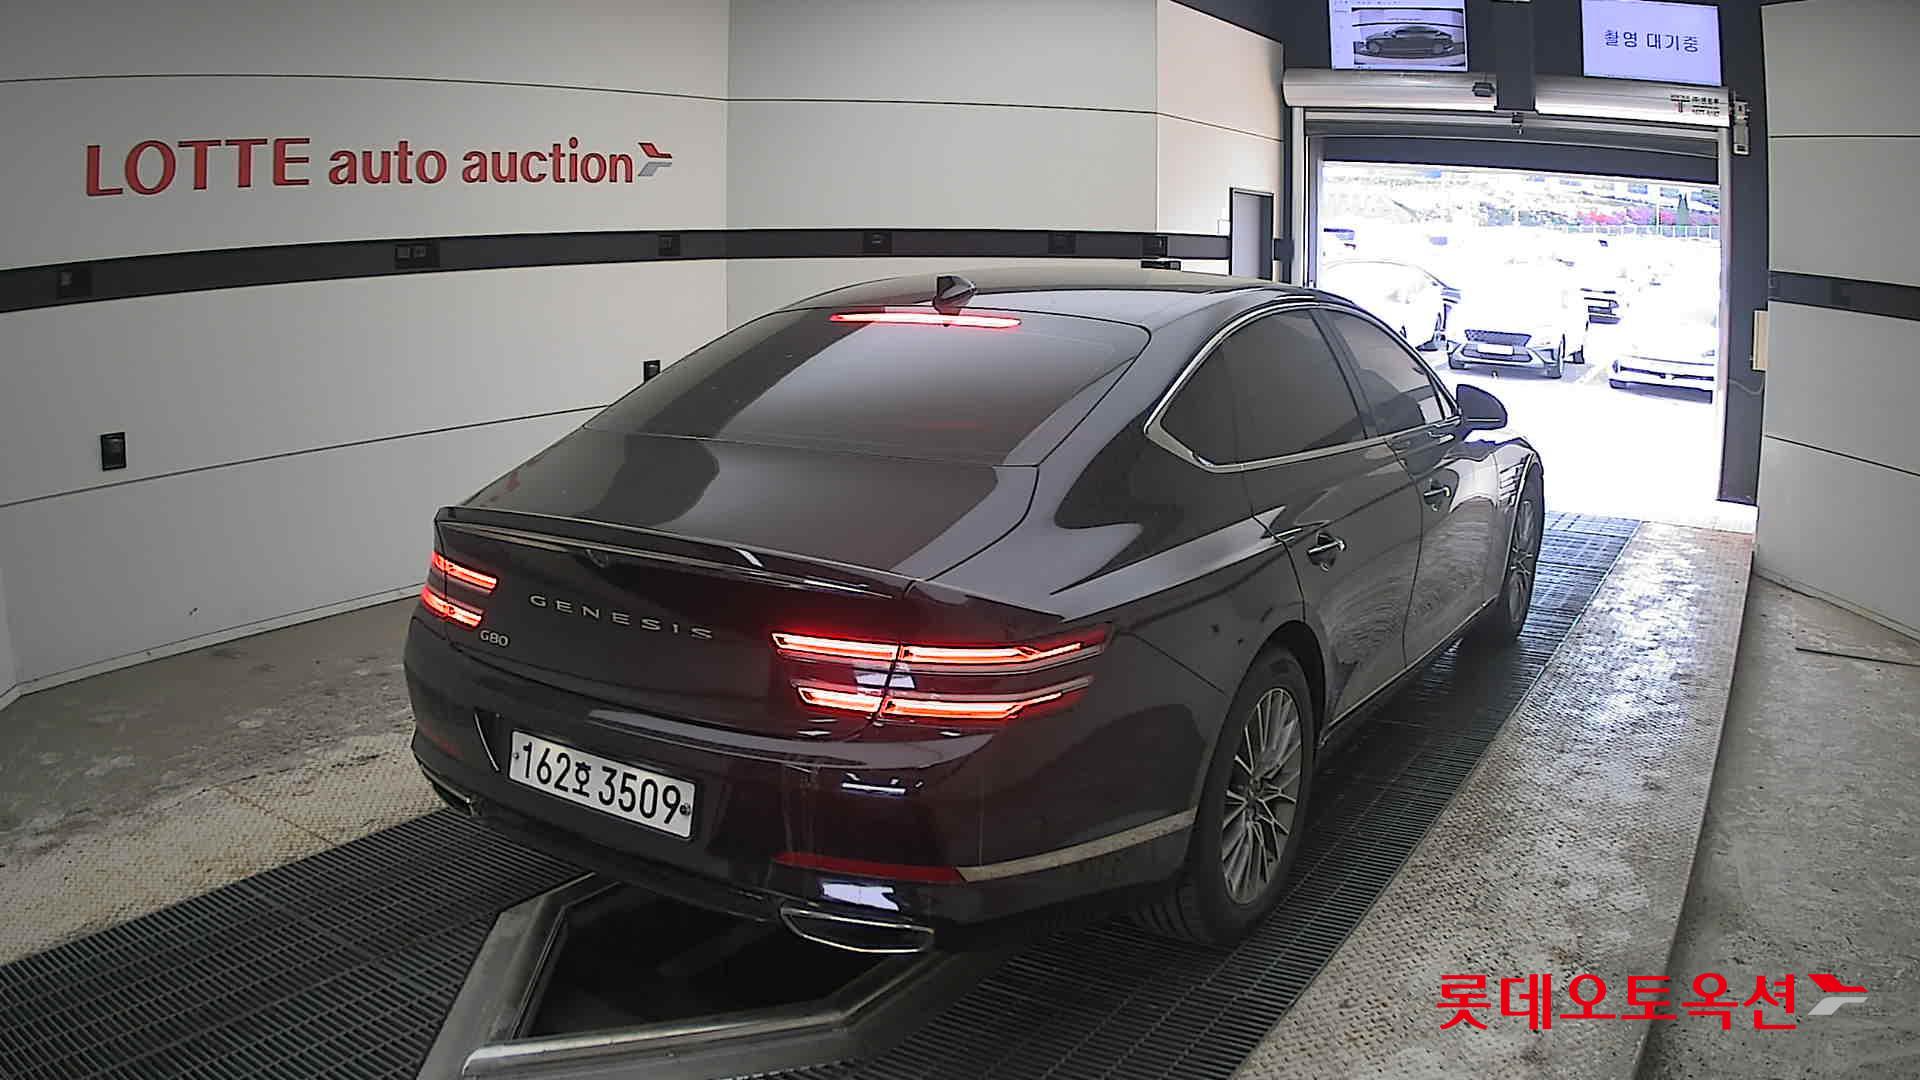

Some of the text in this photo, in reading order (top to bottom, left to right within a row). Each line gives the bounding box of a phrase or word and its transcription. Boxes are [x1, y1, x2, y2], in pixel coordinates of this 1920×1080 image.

[1647, 33, 1699, 53] 대기중
[86, 136, 634, 197] LOTTE auto auction
[480, 629, 510, 648] G80
[529, 594, 714, 640] GENESIS
[522, 741, 682, 825] 162호 3509
